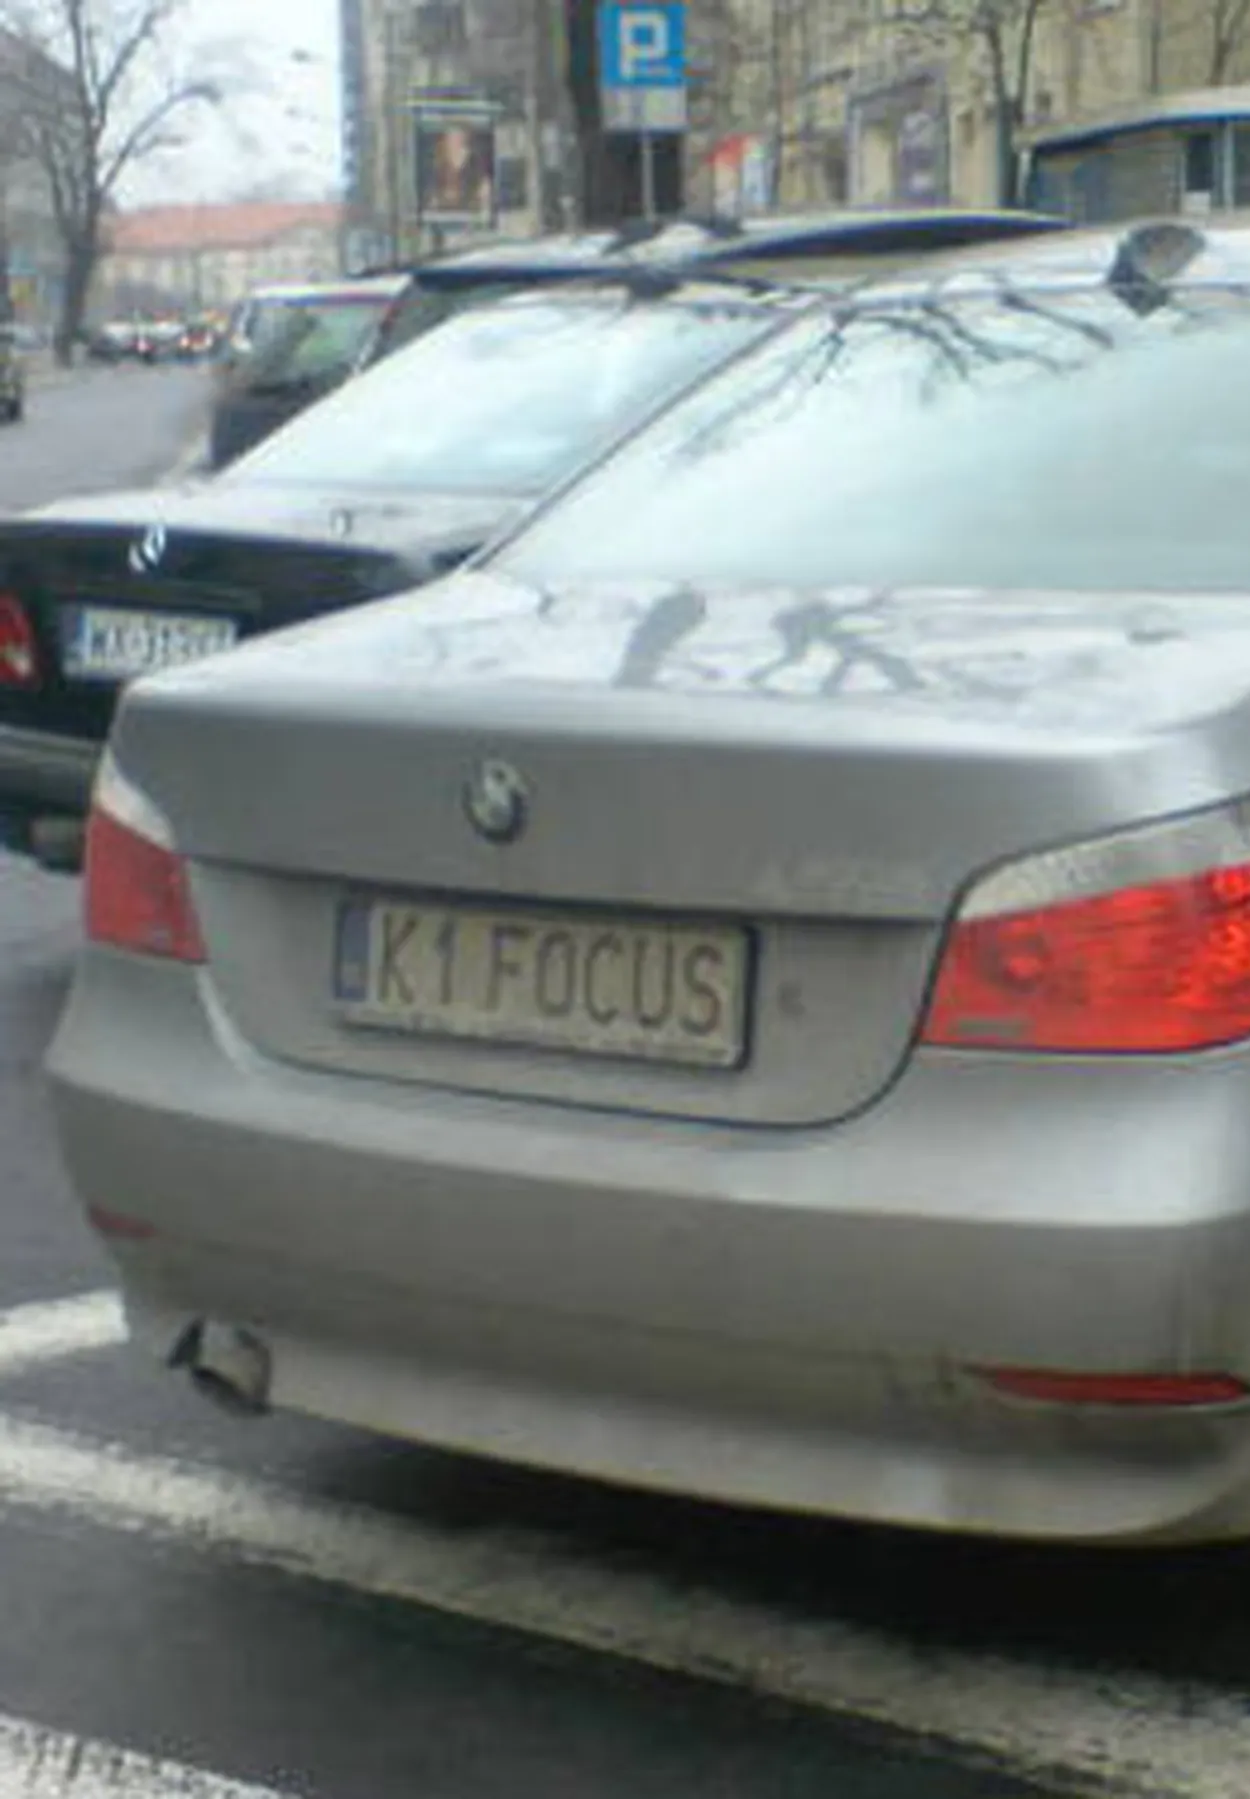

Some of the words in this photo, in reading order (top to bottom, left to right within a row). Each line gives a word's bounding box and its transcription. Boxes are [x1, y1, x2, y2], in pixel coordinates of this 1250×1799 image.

[619, 10, 668, 80] P
[379, 909, 456, 1006] K1
[485, 923, 724, 1037] FOCUS
